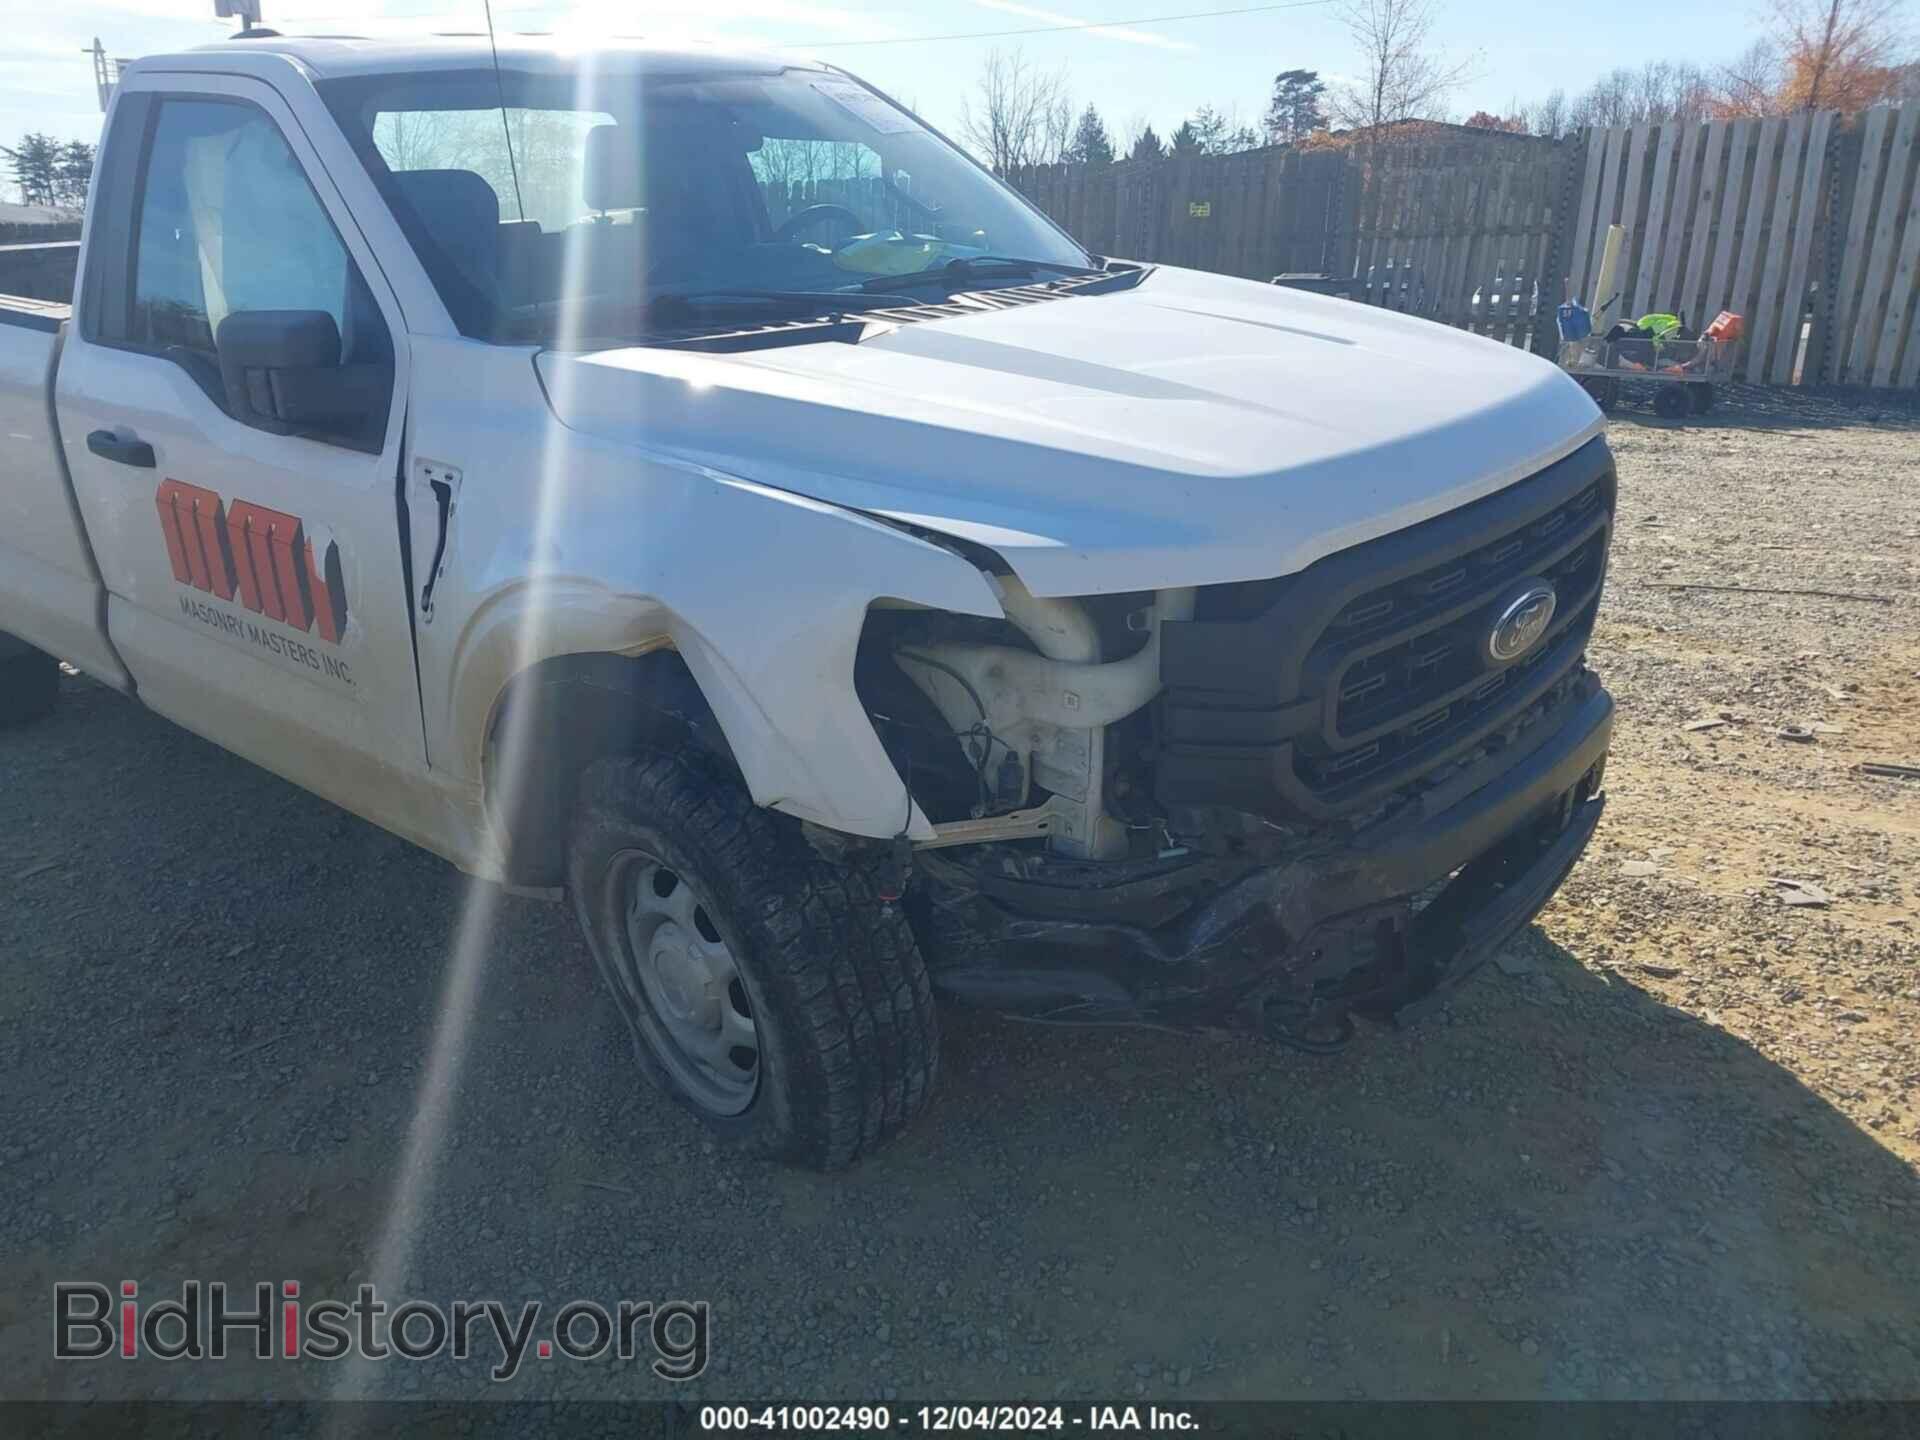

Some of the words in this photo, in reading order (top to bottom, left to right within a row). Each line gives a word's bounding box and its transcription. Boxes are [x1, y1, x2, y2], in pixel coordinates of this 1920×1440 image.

[179, 596, 245, 639] MASONRY
[248, 624, 321, 671] MASTERS
[321, 656, 357, 686] INC.
